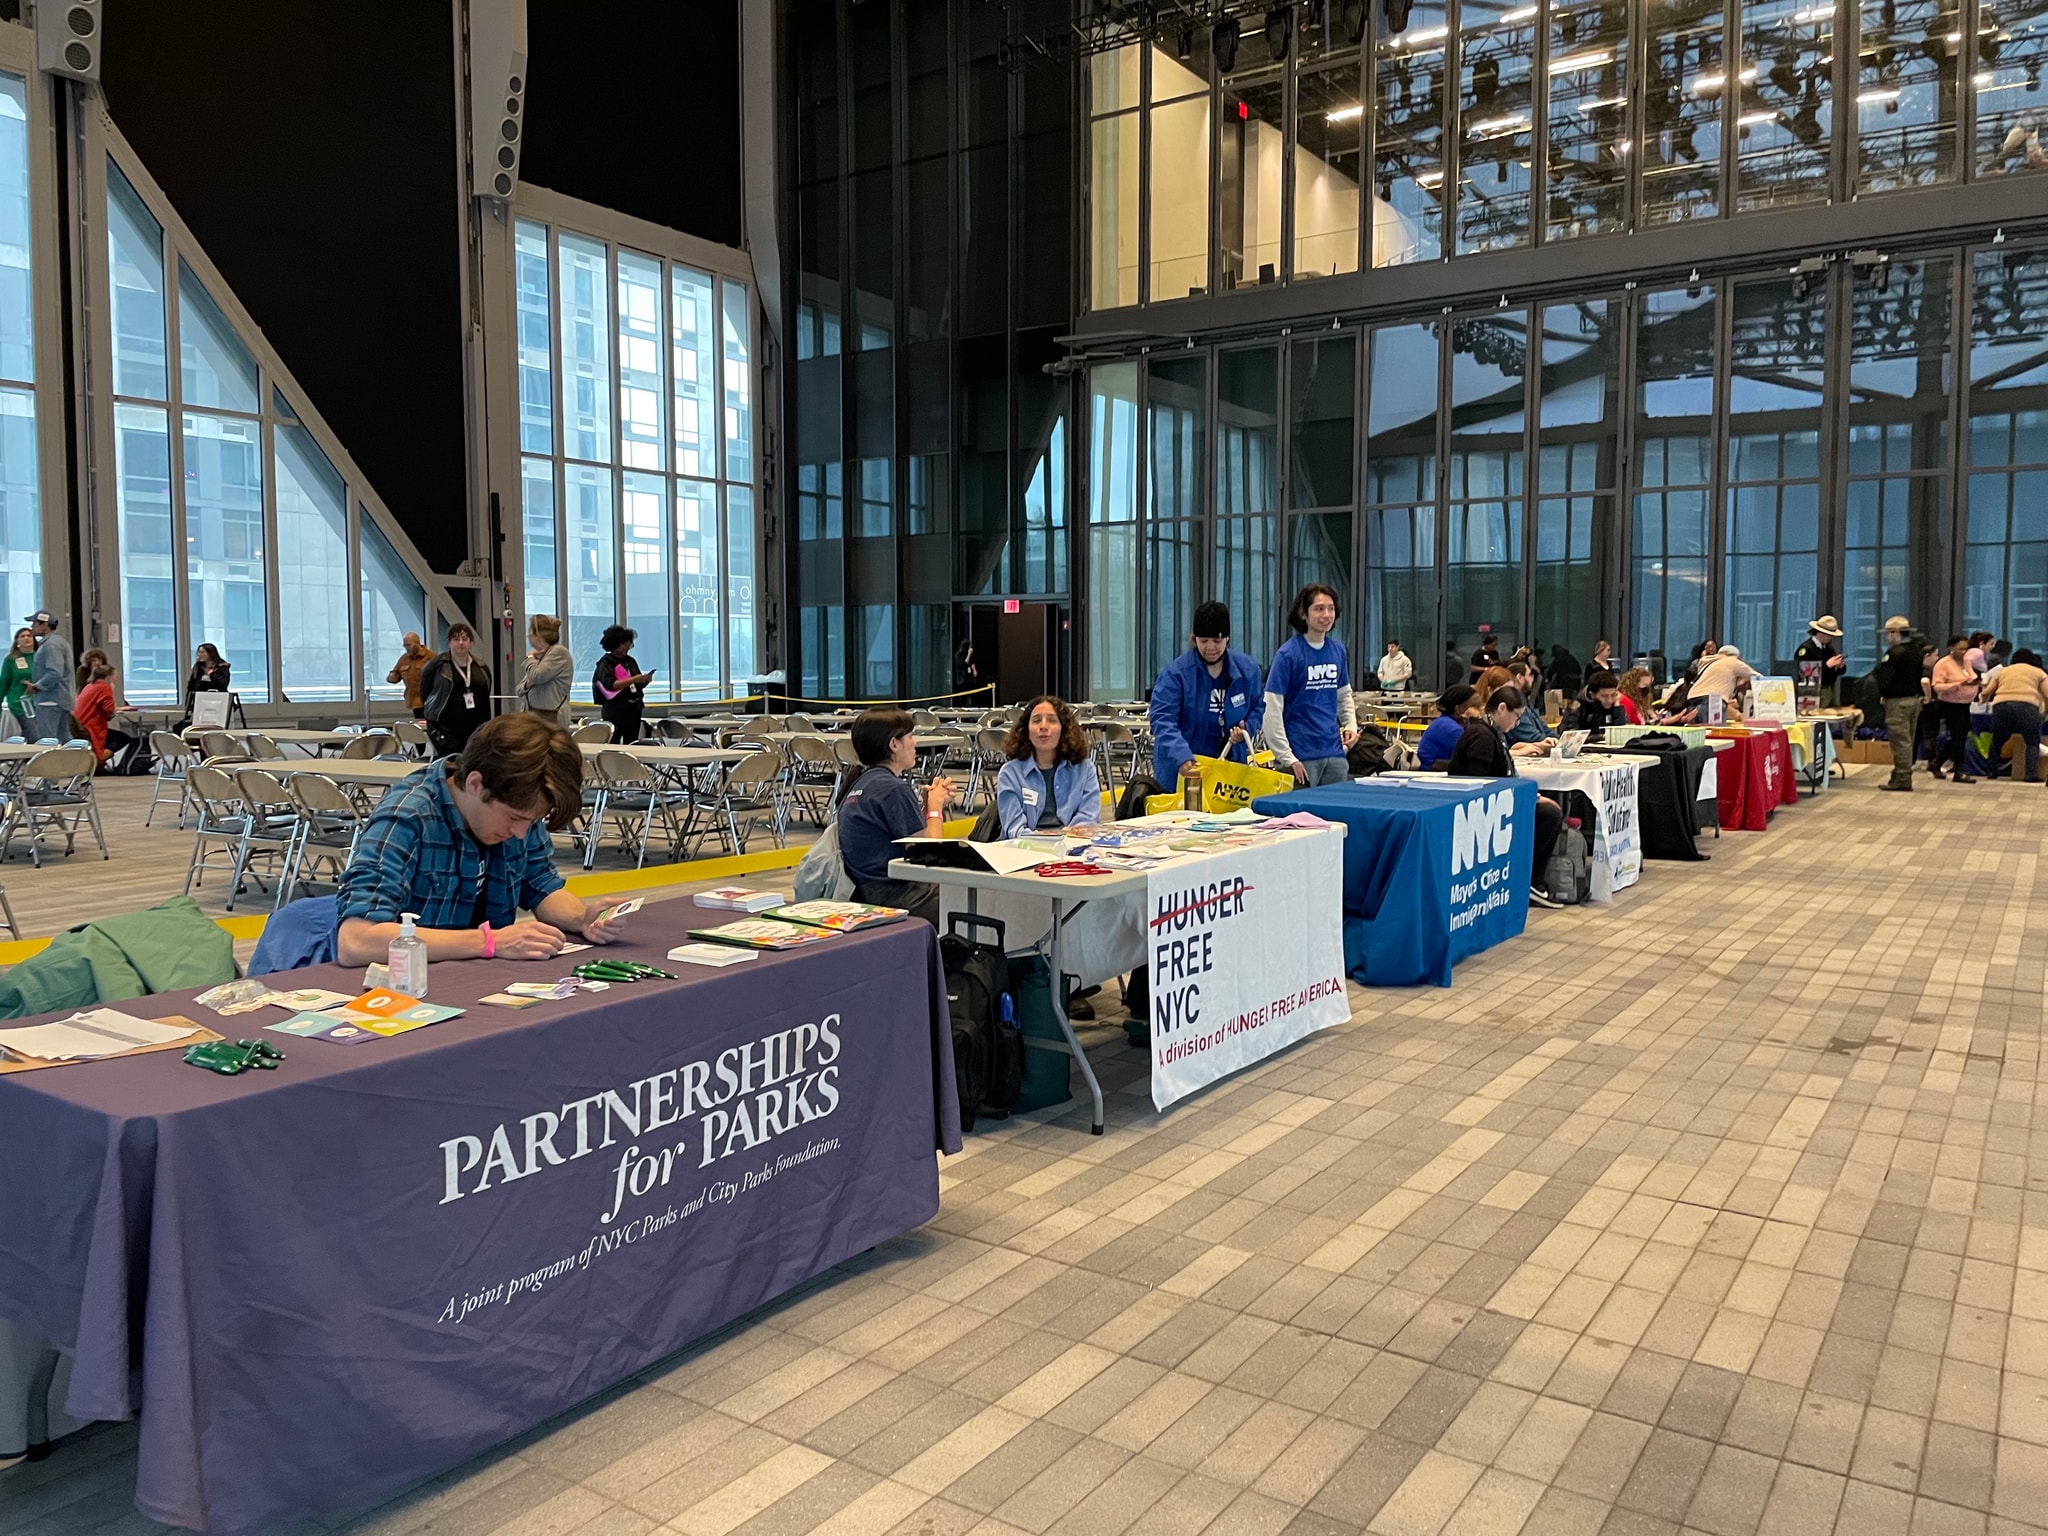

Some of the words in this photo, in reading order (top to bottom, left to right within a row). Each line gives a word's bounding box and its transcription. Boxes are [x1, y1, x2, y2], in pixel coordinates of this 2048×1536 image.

[1308, 664, 1338, 680] NYC
[1214, 781, 1250, 801] NYC
[1451, 788, 1514, 875] NYC
[1157, 876, 1245, 936] HUNGER
[1156, 932, 1213, 986] FREE
[1156, 984, 1200, 1037] NYC
[1166, 1035, 1213, 1064] division
[1214, 1028, 1226, 1046] of
[1271, 993, 1296, 1020] FREE
[438, 1013, 842, 1205] PARTNERSHIPS
[600, 1142, 685, 1223] for
[698, 1066, 840, 1169] PARKS
[437, 1297, 457, 1324] A
[456, 1281, 504, 1324] joint
[505, 1256, 576, 1302] program
[578, 1234, 599, 1269] of
[594, 1225, 639, 1257] NYC
[640, 1206, 678, 1238] Parks
[680, 1194, 706, 1219] and
[708, 1179, 739, 1206] City
[741, 1163, 774, 1194] Parks
